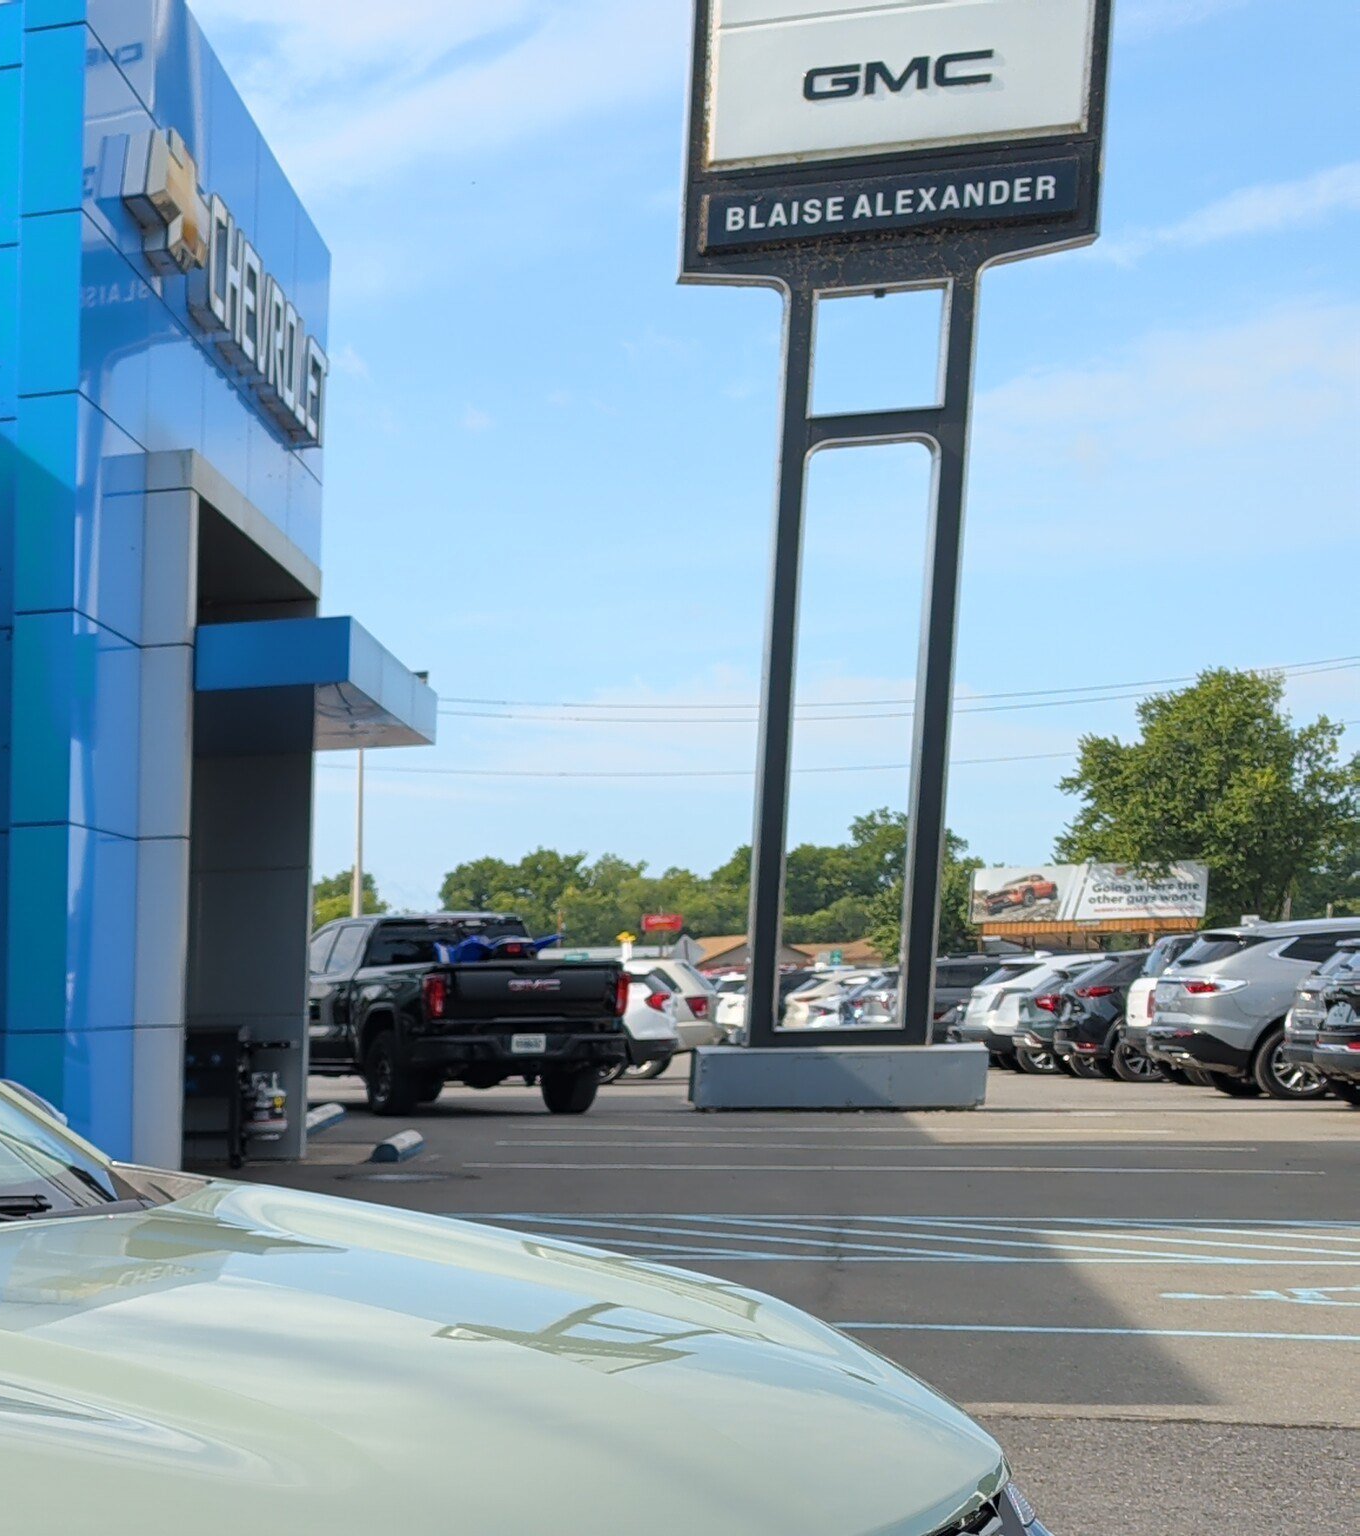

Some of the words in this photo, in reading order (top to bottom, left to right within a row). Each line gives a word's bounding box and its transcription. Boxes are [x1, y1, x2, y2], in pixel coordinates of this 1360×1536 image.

[802, 48, 995, 103] GMC
[724, 194, 845, 233] BLAISE
[851, 173, 1058, 220] ALEXANDER
[207, 191, 331, 449] CHEVROLET
[1088, 893, 1123, 905] other
[1126, 894, 1157, 905] guys
[1092, 882, 1132, 894] Going
[1177, 881, 1201, 891] the
[508, 978, 561, 992] GMC
